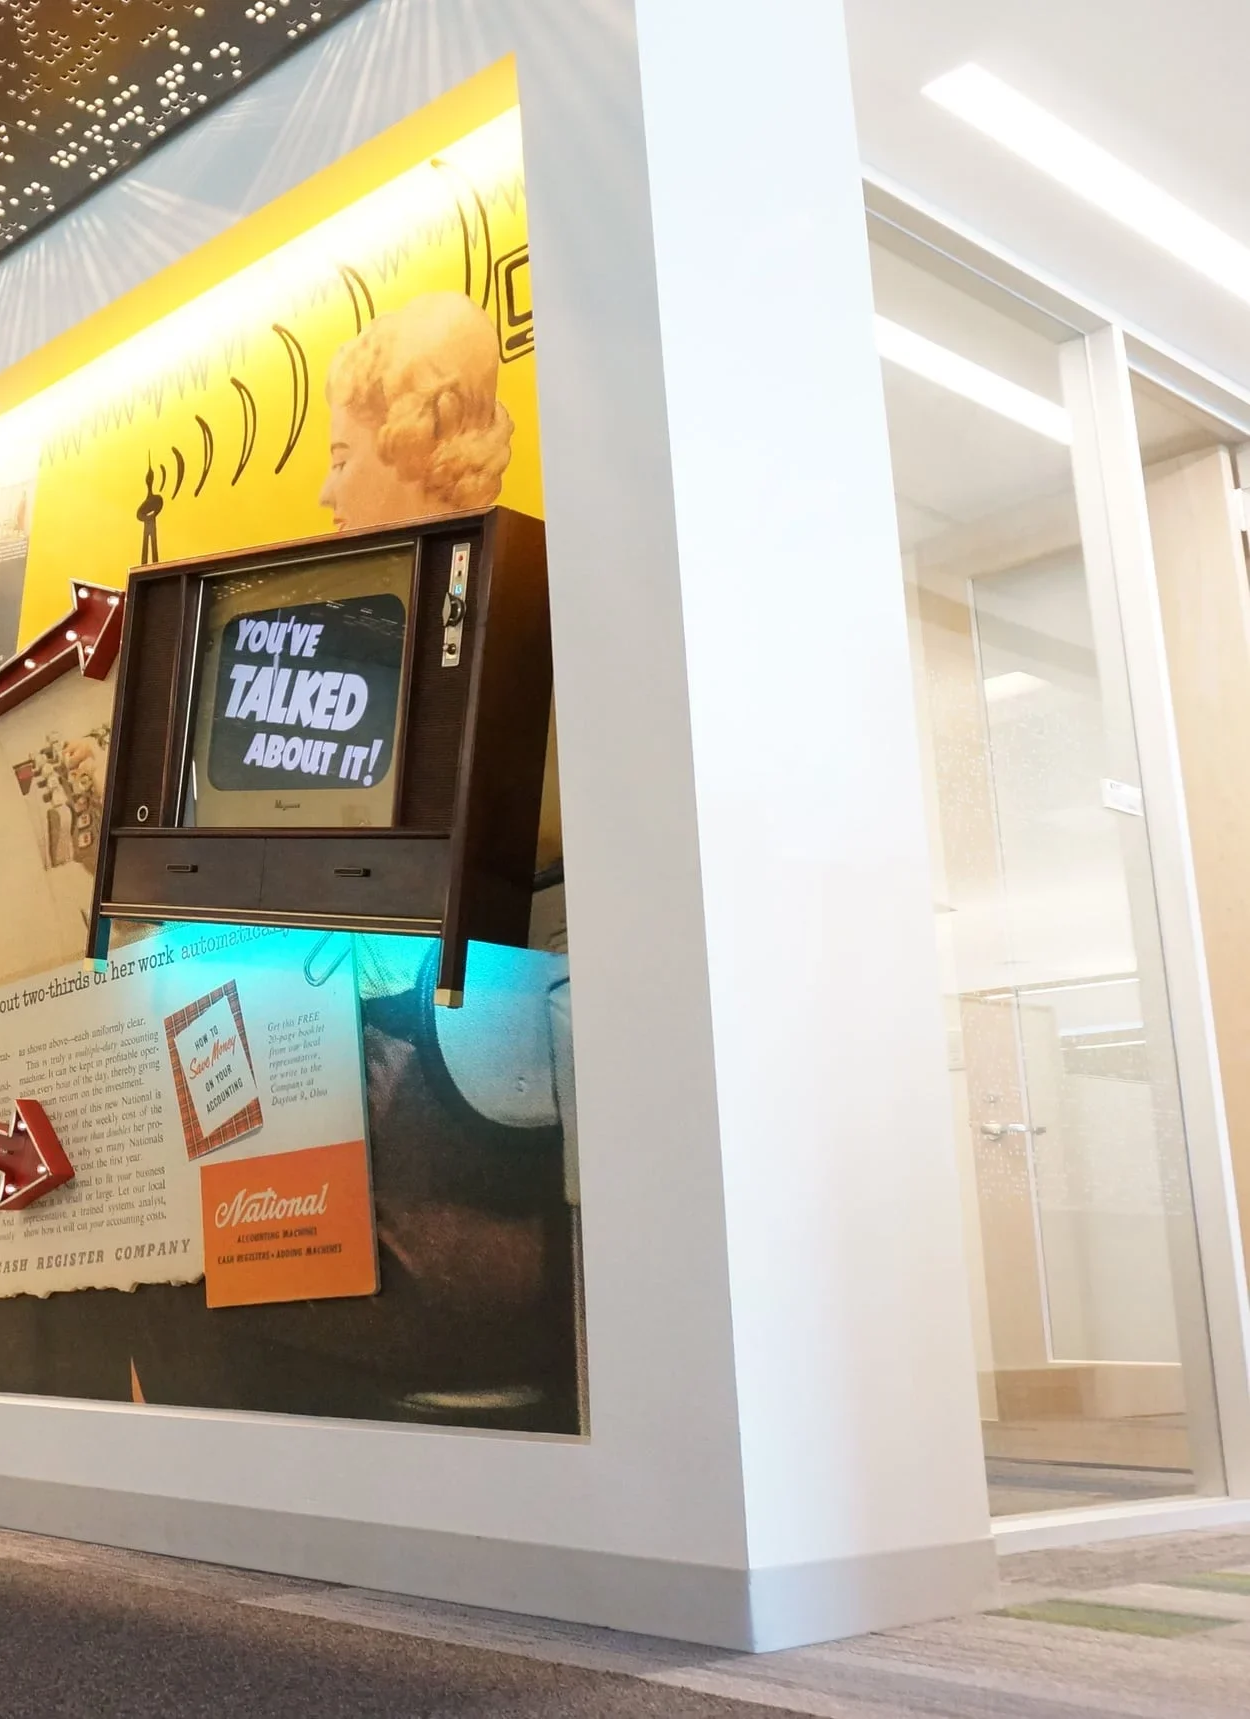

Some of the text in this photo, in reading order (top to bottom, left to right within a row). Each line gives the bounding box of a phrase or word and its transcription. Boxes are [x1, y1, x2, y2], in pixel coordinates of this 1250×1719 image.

[235, 616, 324, 657] YOU'VE
[224, 664, 368, 731] TALKED
[243, 733, 384, 787] ABOUT IT!
[23, 972, 90, 1007] two-thirds
[110, 960, 134, 981] her
[138, 945, 174, 973] work
[182, 926, 289, 960] automaticay
[268, 1020, 280, 1032] Get
[298, 1011, 320, 1025] FREE
[26, 1060, 40, 1071] This
[50, 1054, 66, 1067] truly
[120, 1030, 159, 1048] accounting
[27, 1042, 47, 1056] shown
[92, 1021, 125, 1039] uniformly
[127, 1017, 146, 1030] clear.
[194, 1025, 218, 1050] HOW TO
[303, 1036, 321, 1049] local
[56, 1067, 67, 1077] can
[70, 1064, 76, 1073] be
[79, 1059, 94, 1074] kept
[96, 1058, 103, 1067] in
[105, 1048, 139, 1068] profitable
[140, 1046, 160, 1060] oper-
[189, 1034, 237, 1080] Save Money
[300, 1064, 308, 1074] to
[310, 1062, 322, 1072] the
[37, 1084, 54, 1096] every
[56, 1080, 71, 1091] hour
[73, 1076, 81, 1088] of
[82, 1073, 93, 1085] the
[111, 1064, 136, 1080] thereby
[138, 1058, 160, 1076] giving
[59, 1092, 79, 1103] return
[80, 1089, 90, 1099] on
[92, 1084, 103, 1096] the
[105, 1078, 145, 1094] investment.
[205, 1064, 232, 1092] ON YOUR
[50, 1090, 162, 1123] ekly cost of this new National is
[206, 1078, 244, 1114] ACCOUNTING
[271, 1092, 298, 1106] Dayton
[309, 1086, 328, 1098] Ohio
[72, 1120, 80, 1131] of
[82, 1118, 93, 1129] the
[95, 1112, 118, 1126] weekly
[122, 1109, 136, 1121] cost
[139, 1104, 148, 1116] of
[150, 1104, 162, 1115] the
[133, 1122, 145, 1133] her
[147, 1120, 163, 1135] pro-
[78, 1148, 91, 1161] why
[95, 1145, 103, 1154] so
[106, 1142, 125, 1156] many
[129, 1133, 164, 1148] Nationals
[77, 1160, 94, 1171] cost
[96, 1157, 108, 1168] the
[110, 1154, 123, 1166] first
[126, 1152, 143, 1168] year.
[85, 1191, 93, 1200] or
[118, 1184, 129, 1196] Let
[133, 1184, 145, 1194] our
[148, 1178, 166, 1192] local
[95, 1176, 103, 1186] to
[135, 1166, 166, 1180] business
[80, 1204, 104, 1217] trained
[108, 1200, 135, 1213] systems
[138, 1194, 167, 1208] analyst,
[215, 1182, 329, 1228] National
[24, 1227, 39, 1238] show
[56, 1224, 62, 1234] it
[63, 1222, 75, 1234] will
[76, 1220, 88, 1231] cut
[89, 1220, 104, 1234] your
[106, 1212, 145, 1228] accounting
[146, 1210, 167, 1223] costs,
[237, 1226, 318, 1244] ACCOUNTING MACHINES
[36, 1248, 104, 1270] REGISTER
[114, 1238, 191, 1265] COMPANY
[218, 1254, 234, 1265] CASH
[276, 1248, 303, 1259] ADDING
[305, 1243, 342, 1256] MACHINES
